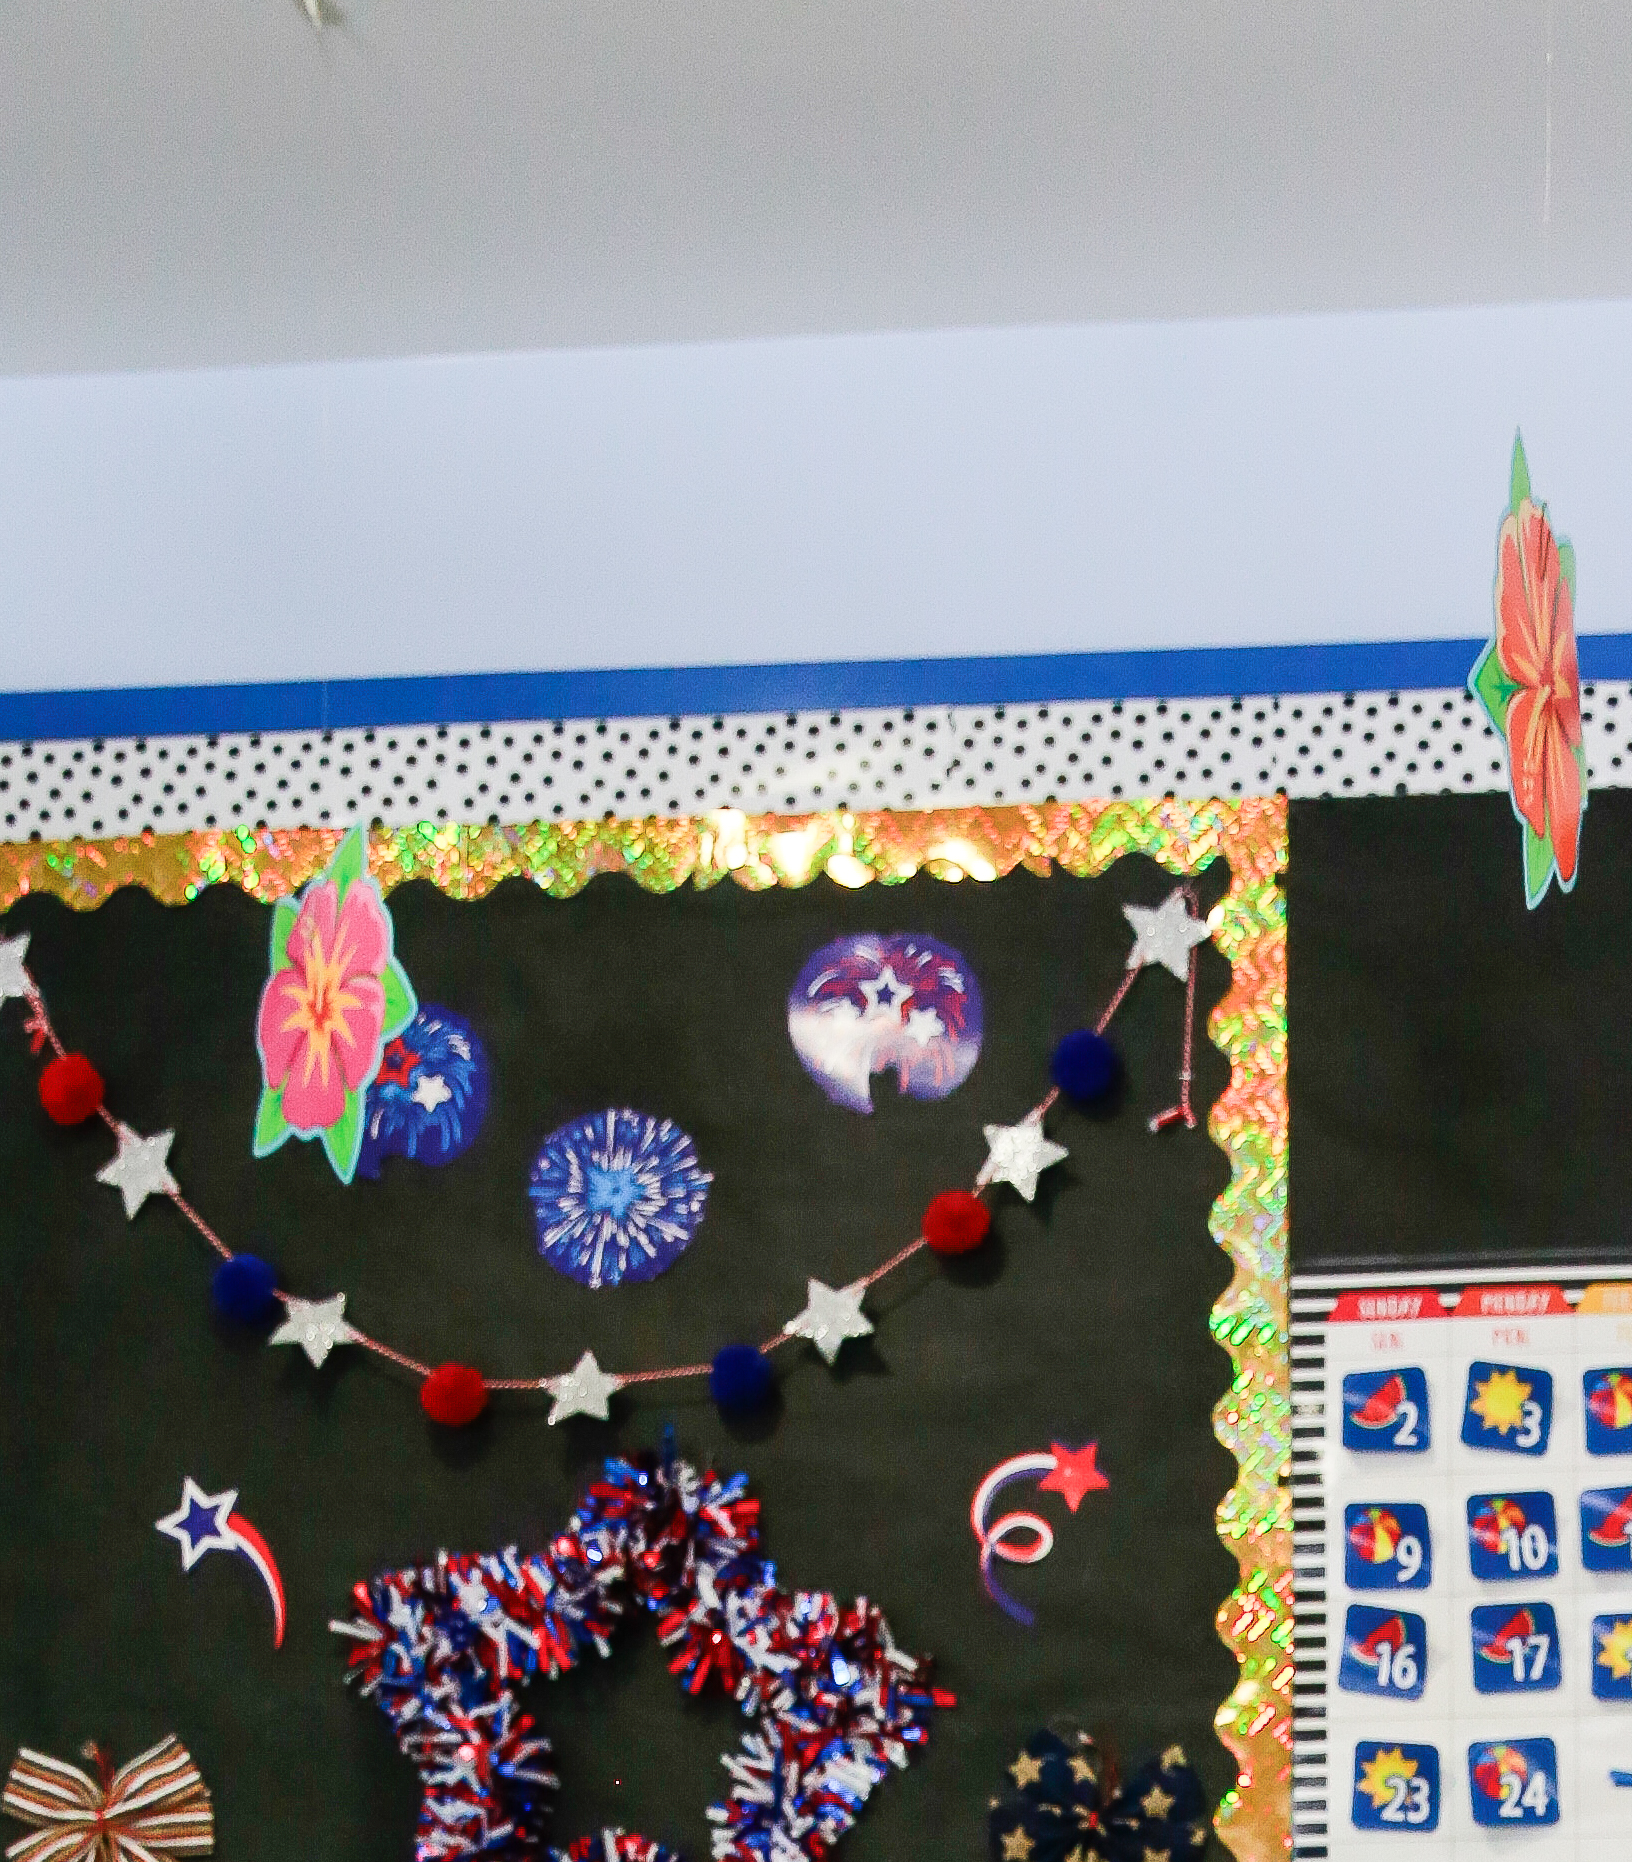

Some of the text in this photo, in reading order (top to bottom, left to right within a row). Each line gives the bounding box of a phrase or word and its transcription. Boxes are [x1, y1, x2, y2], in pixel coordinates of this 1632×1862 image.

[1393, 1401, 1418, 1446] 2
[1515, 1400, 1543, 1448] 3
[1395, 1535, 1422, 1582] 9
[1501, 1524, 1549, 1571] 10
[1375, 1641, 1418, 1690] 16
[1505, 1634, 1550, 1682] 17
[1380, 1771, 1549, 1824] 23 24
